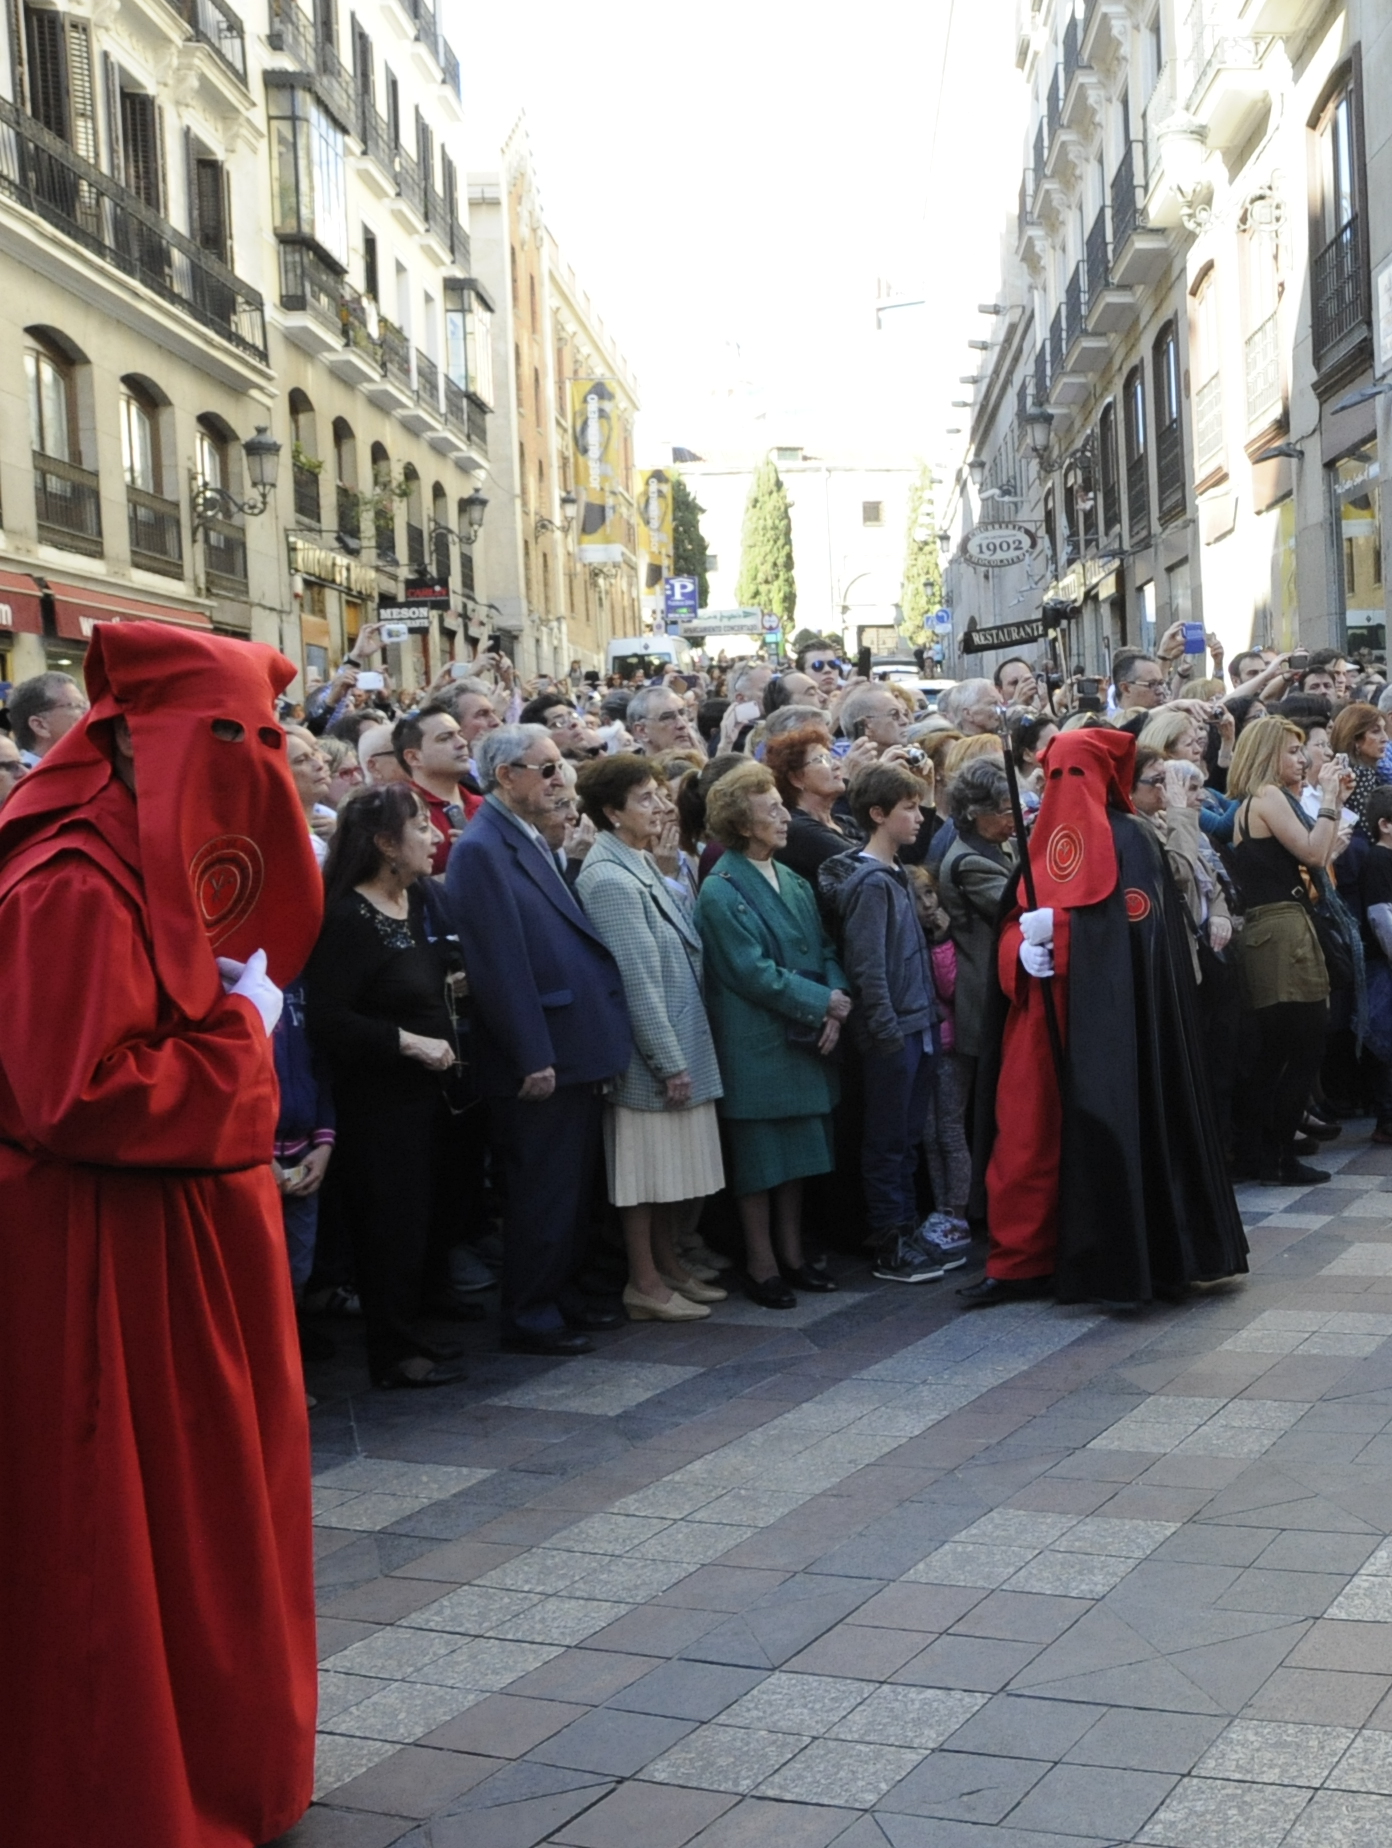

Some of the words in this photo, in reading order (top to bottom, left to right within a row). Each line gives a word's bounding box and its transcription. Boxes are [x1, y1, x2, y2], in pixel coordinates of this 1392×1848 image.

[976, 539, 1024, 557] 1902
[671, 581, 695, 601] P
[379, 607, 428, 619] MESON
[971, 622, 1044, 646] RESTAURANTE
